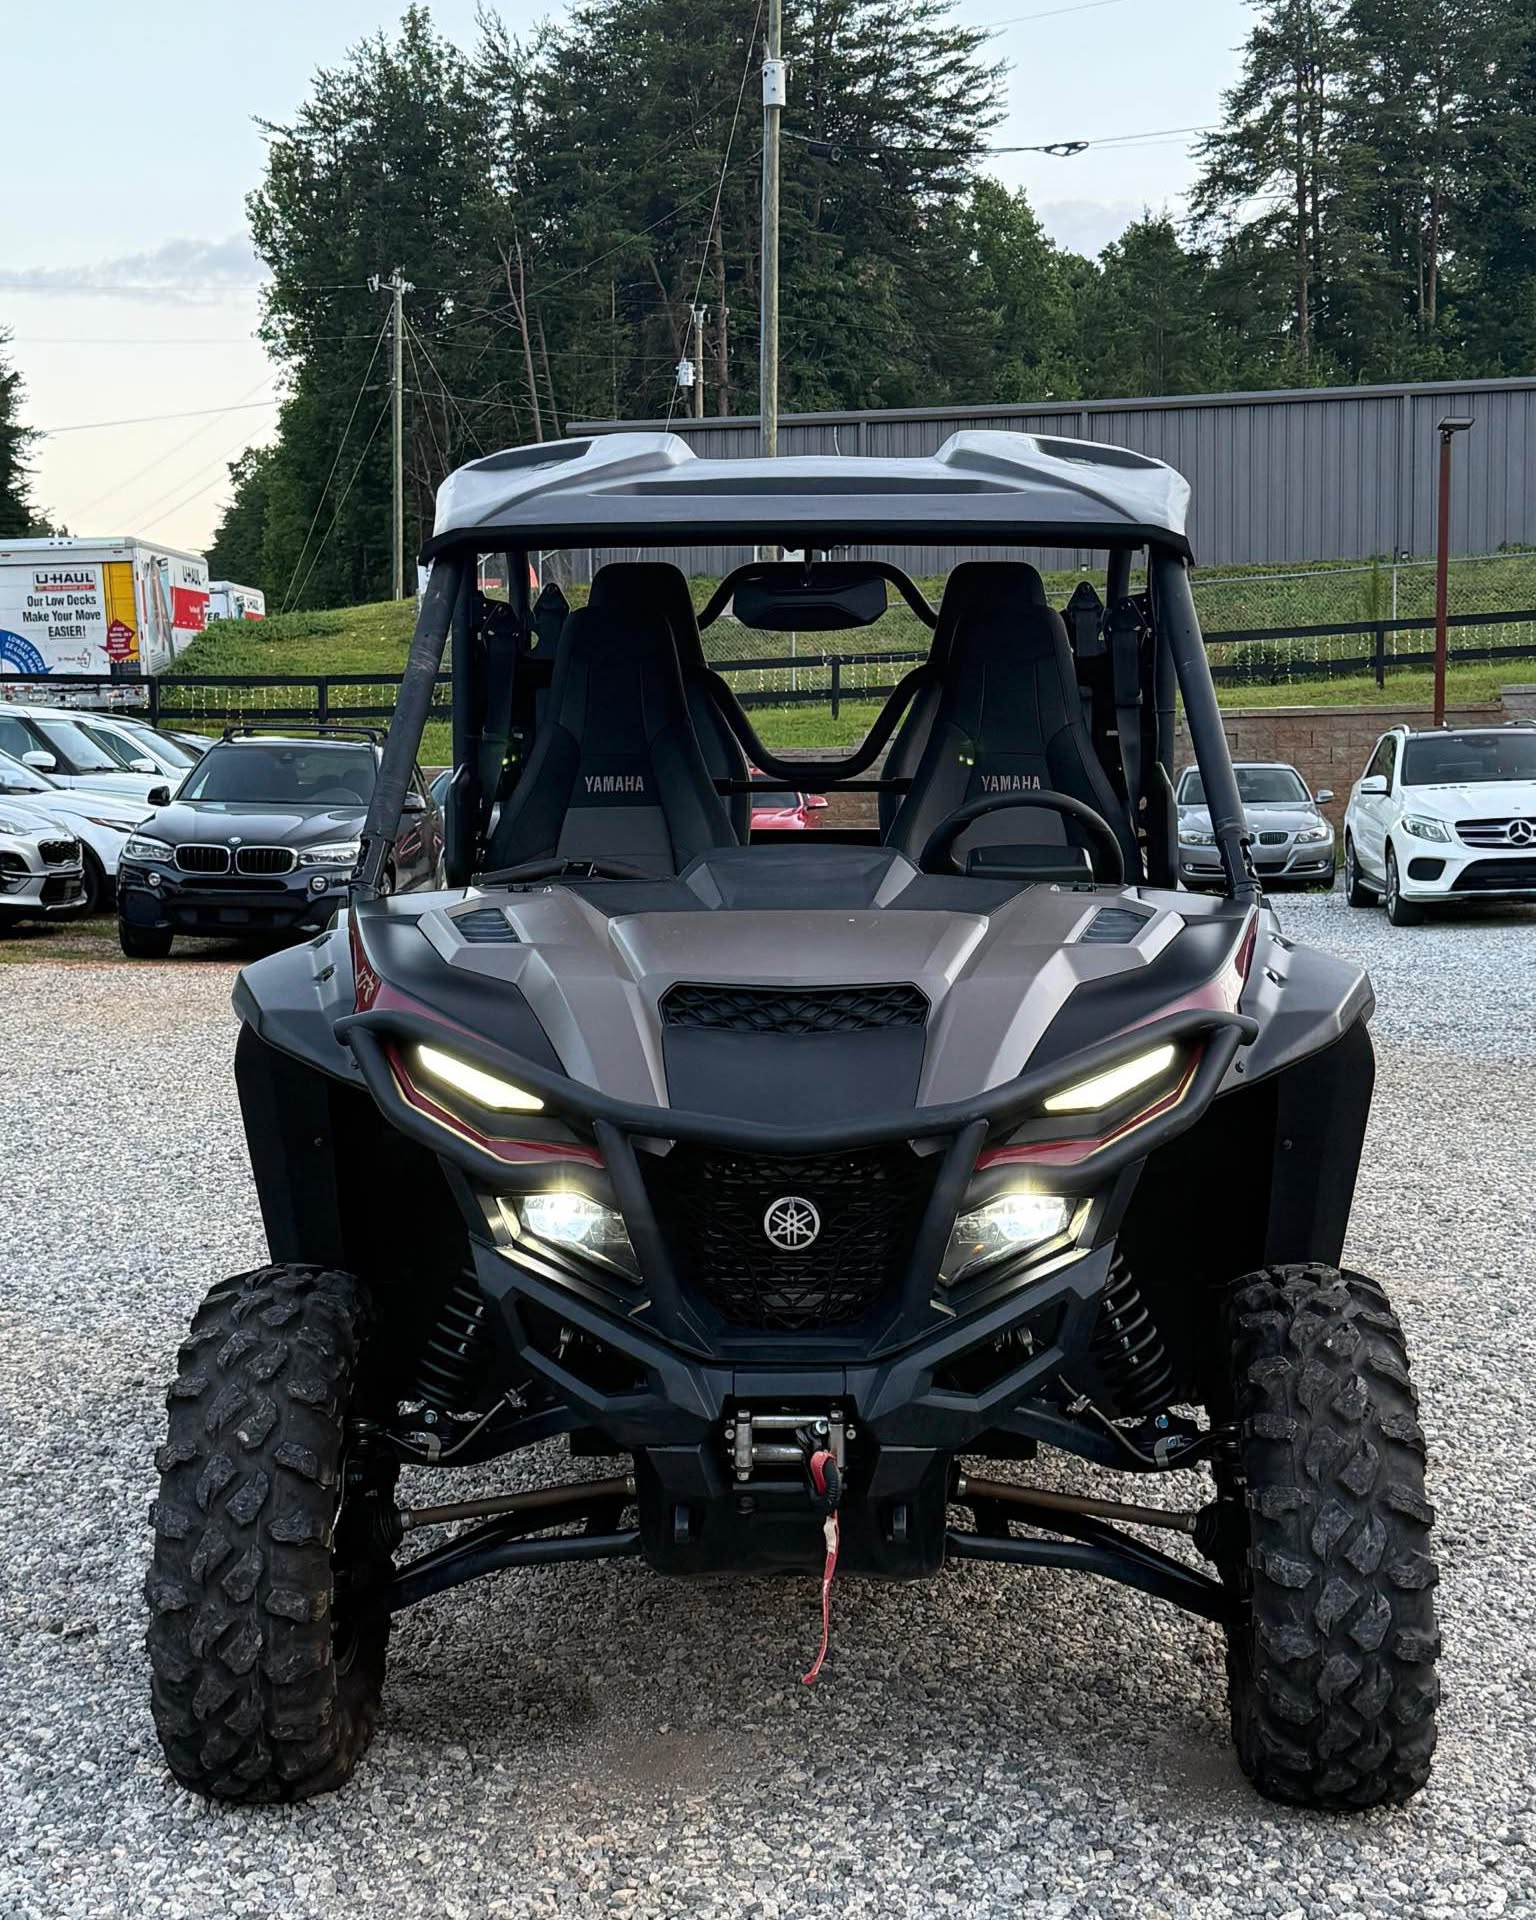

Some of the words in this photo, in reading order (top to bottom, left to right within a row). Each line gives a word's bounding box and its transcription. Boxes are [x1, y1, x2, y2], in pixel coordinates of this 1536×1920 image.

[35, 573, 94, 584] U-HAUL
[27, 595, 44, 607] Our
[45, 595, 65, 607] Low
[67, 593, 97, 606] Decks
[22, 611, 50, 623] Make
[51, 610, 73, 622] Your
[75, 609, 101, 621] Move
[48, 625, 86, 638] EASIER!
[584, 775, 645, 793] YAMAHA
[980, 775, 1041, 792] YAMAHA
